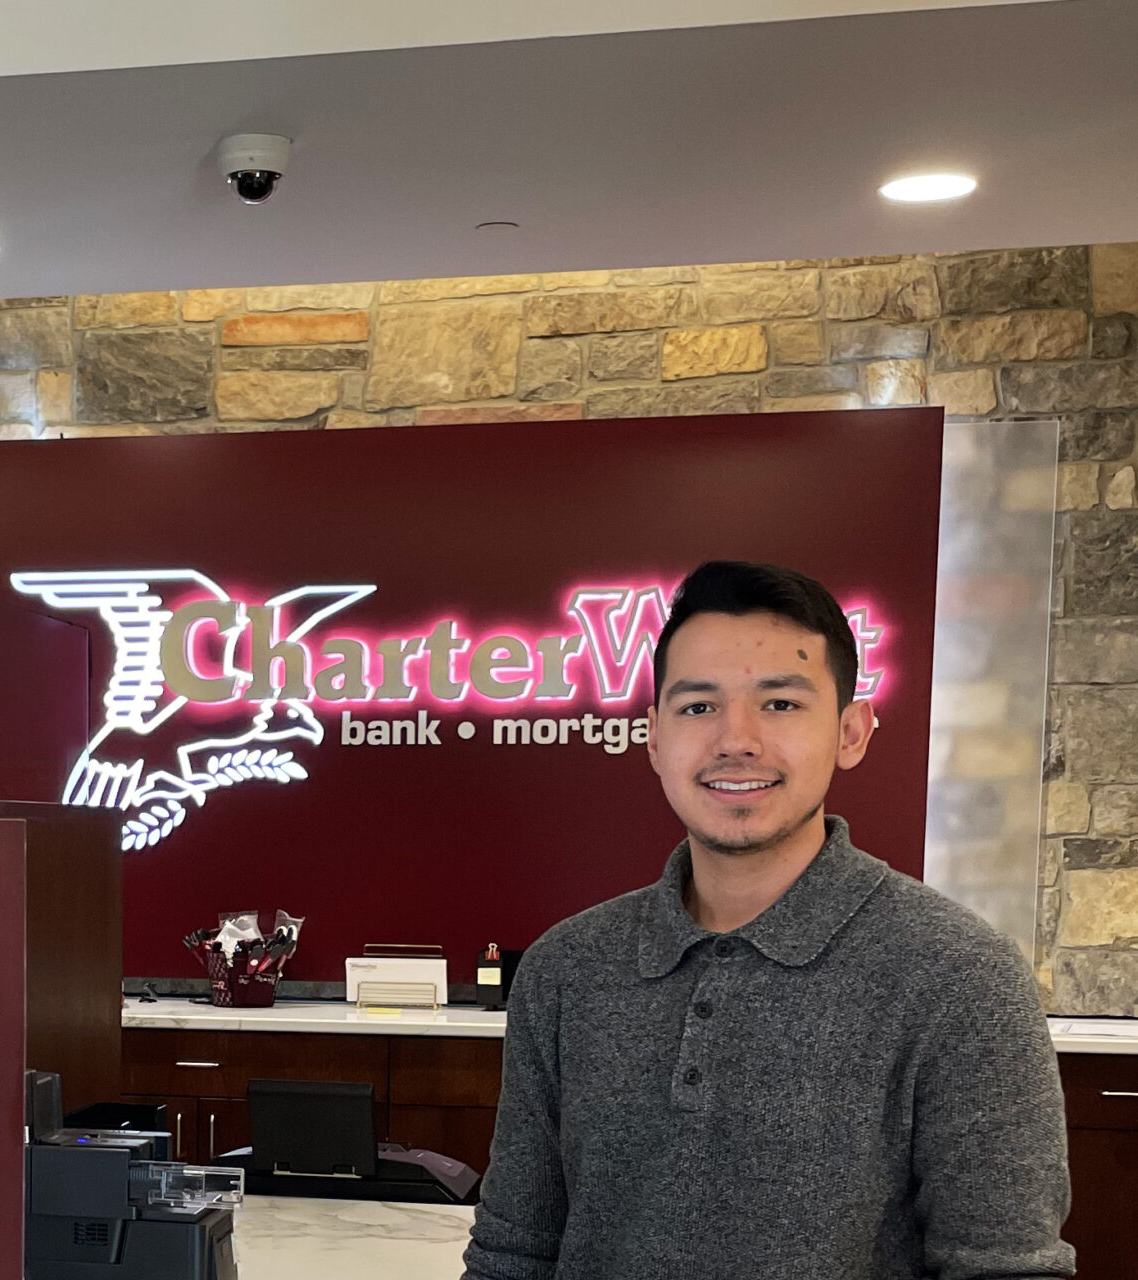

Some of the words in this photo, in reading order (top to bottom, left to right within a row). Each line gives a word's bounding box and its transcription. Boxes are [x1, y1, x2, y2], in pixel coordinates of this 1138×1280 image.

[161, 586, 883, 702] CharterWt
[341, 710, 442, 747] bank
[493, 712, 649, 755] mortga
